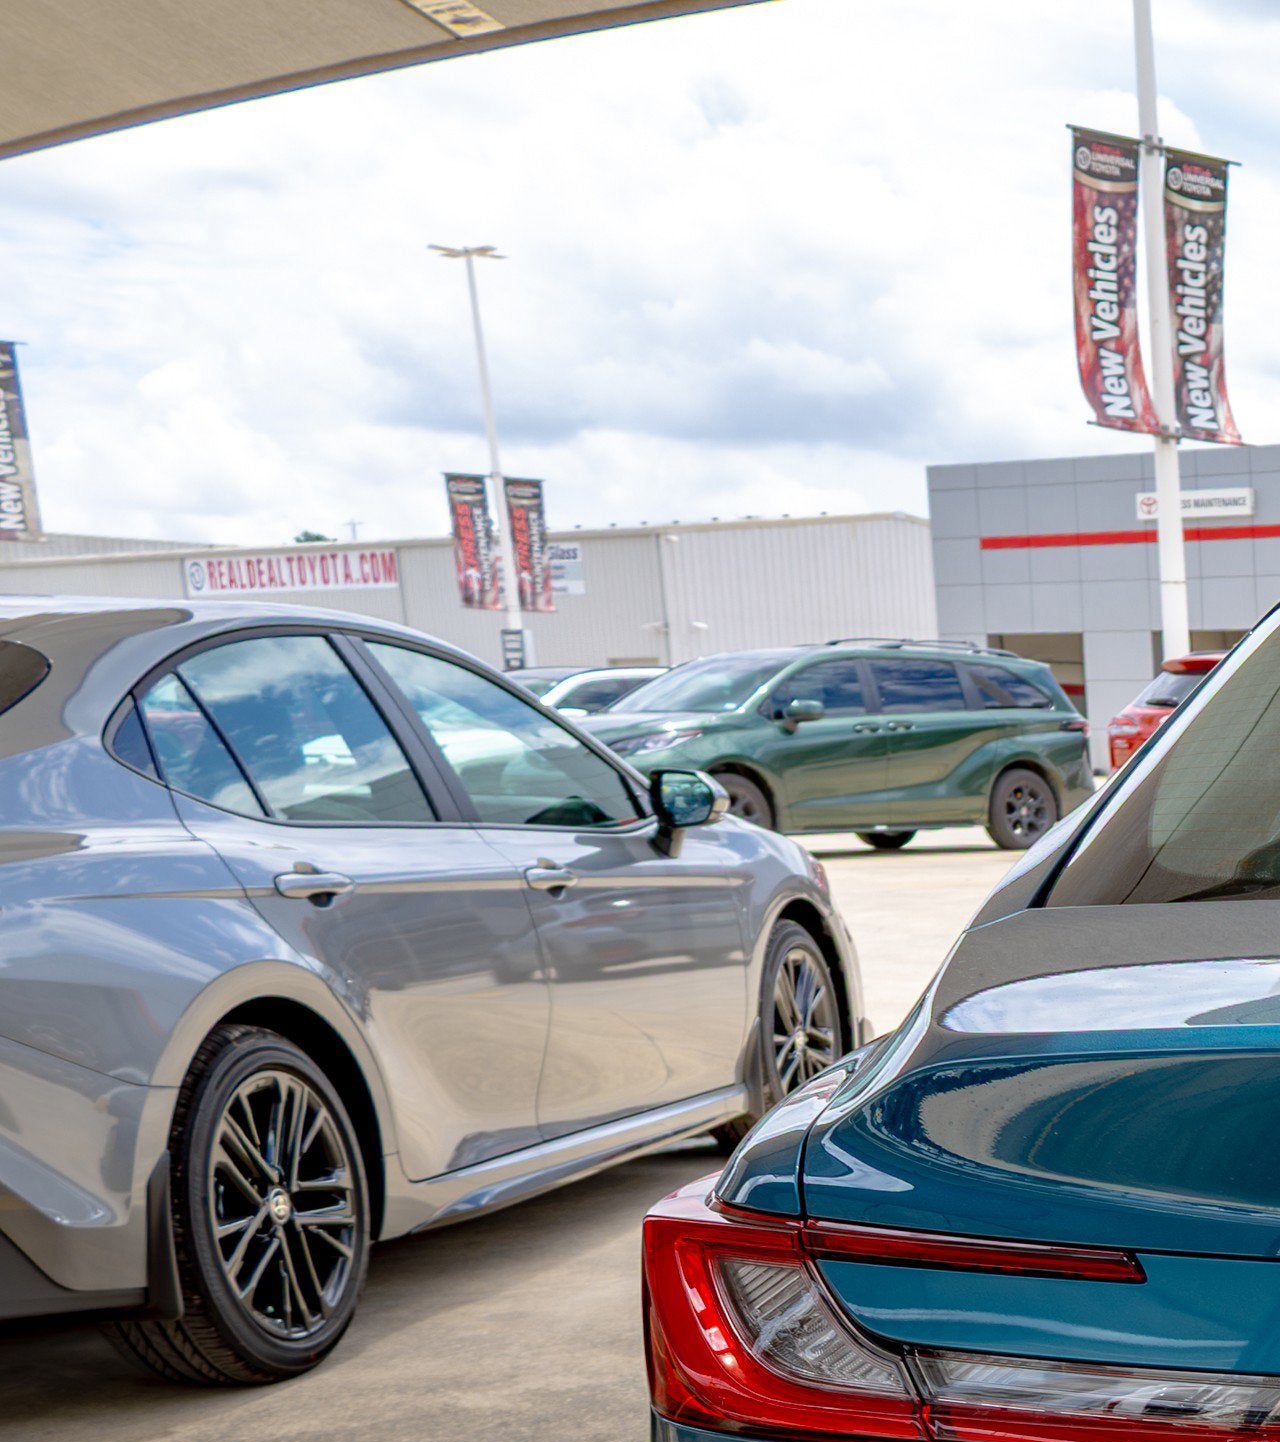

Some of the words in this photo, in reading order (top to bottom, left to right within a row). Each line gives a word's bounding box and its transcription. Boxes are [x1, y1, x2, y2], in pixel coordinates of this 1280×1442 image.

[1088, 206, 1120, 341] Vehicles
[1177, 225, 1208, 355] Vehicles
[1100, 348, 1135, 418] New
[1185, 363, 1218, 430] New
[207, 551, 398, 590] REALDEALTOYOTA.COM
